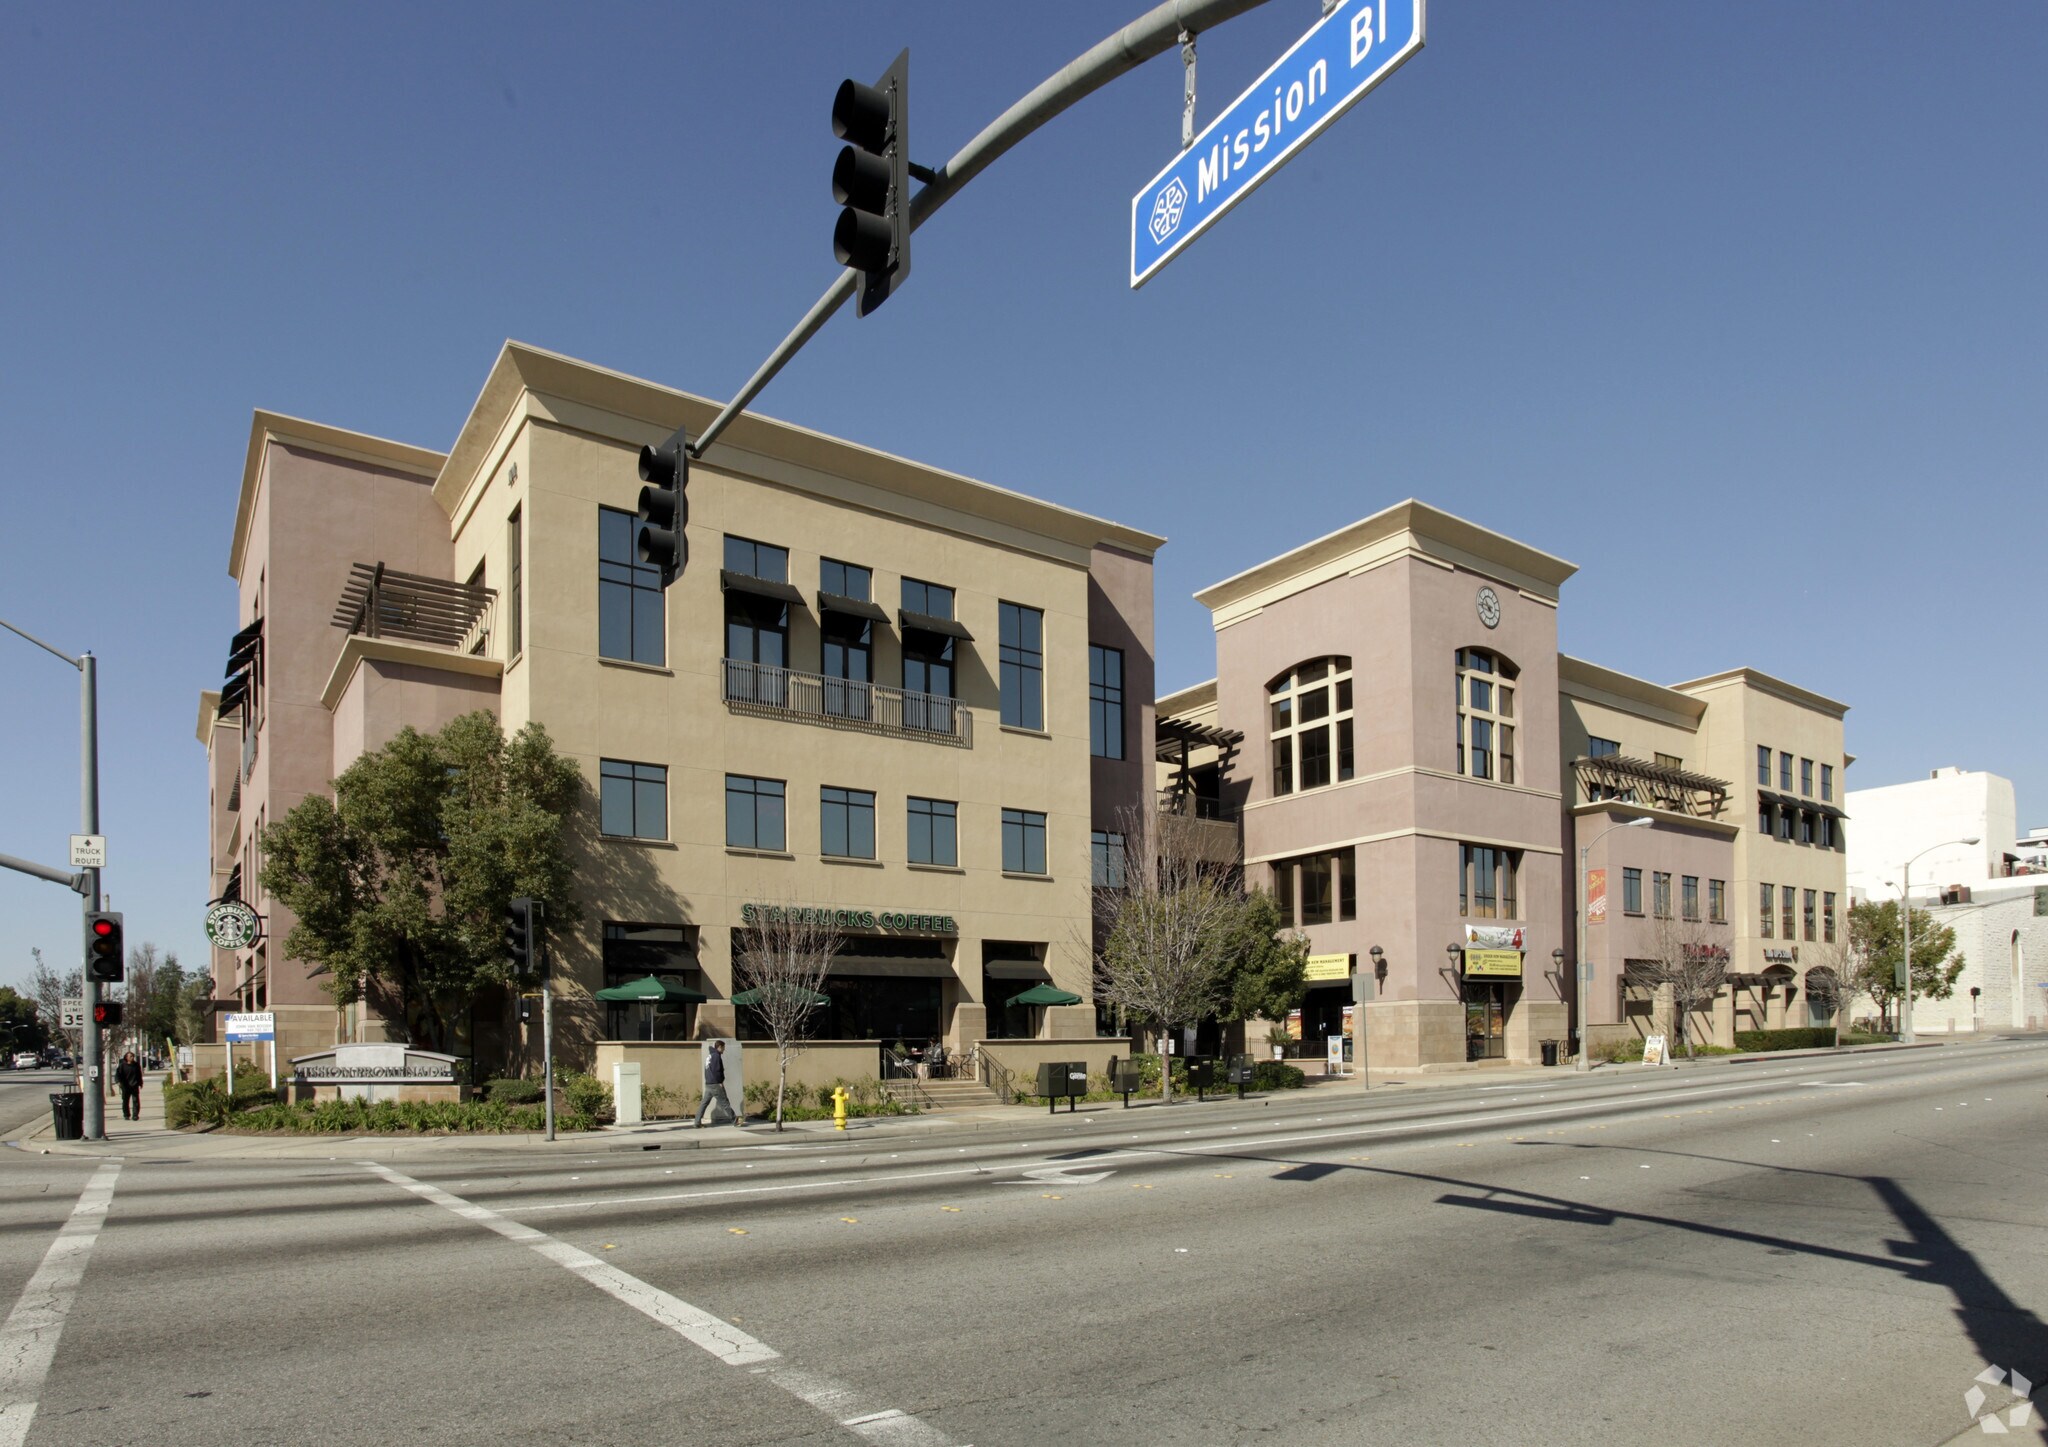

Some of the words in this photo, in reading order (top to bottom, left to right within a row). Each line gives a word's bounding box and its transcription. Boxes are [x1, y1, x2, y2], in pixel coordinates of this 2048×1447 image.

[1198, 58, 1328, 204] Mission
[1350, 0, 1386, 69] Bl
[75, 847, 101, 855] TRUCK
[75, 857, 102, 865] ROUTE
[207, 906, 253, 926] STARBUCKS
[740, 902, 874, 928] STARBUCKS
[879, 911, 954, 931] COFFEE
[212, 934, 248, 948] COFFEE
[64, 1014, 83, 1026] 35
[232, 1014, 272, 1022] AVAILABLE
[294, 1066, 353, 1078] MISSION
[355, 1066, 451, 1078] PROMENADE
